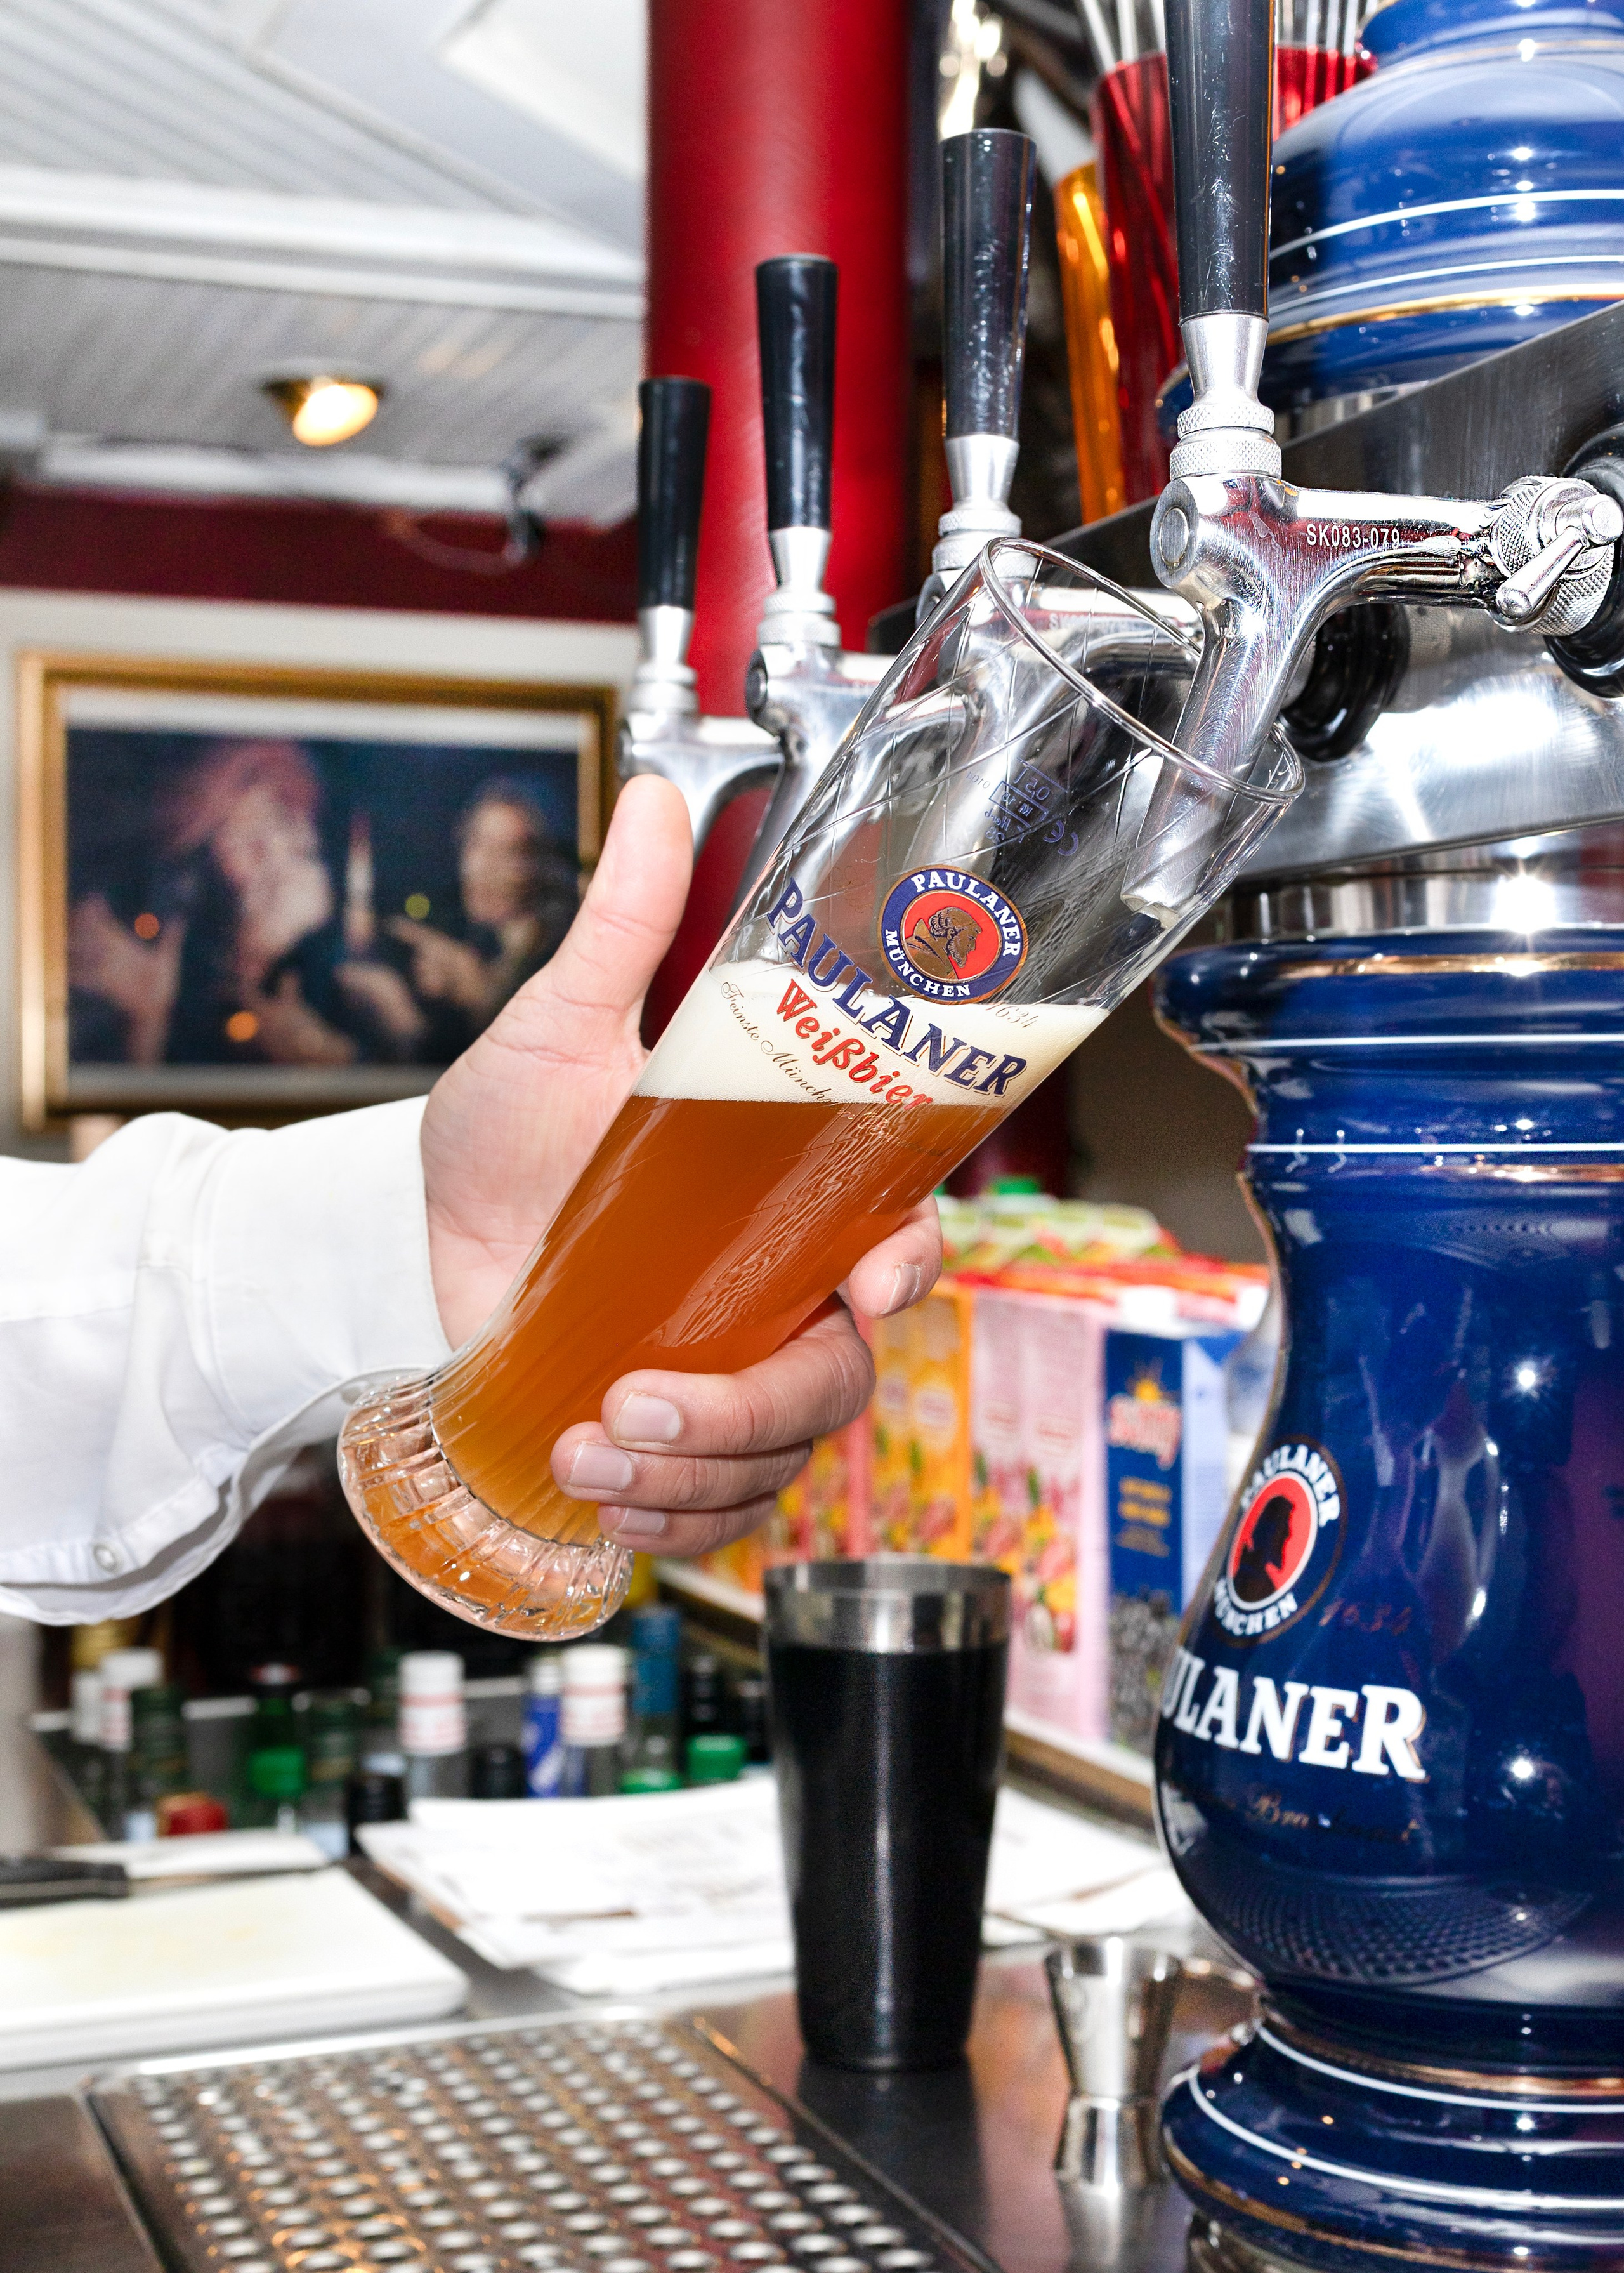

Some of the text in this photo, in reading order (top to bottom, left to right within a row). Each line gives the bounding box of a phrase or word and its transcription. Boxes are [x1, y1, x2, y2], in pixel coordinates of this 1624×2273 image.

[1307, 524, 1400, 550] SK083-079
[911, 871, 1021, 957] PAULANER
[766, 877, 1028, 1097] PAULANER
[885, 929, 971, 998] MÜNCHEN
[776, 978, 934, 1111] Weißbier
